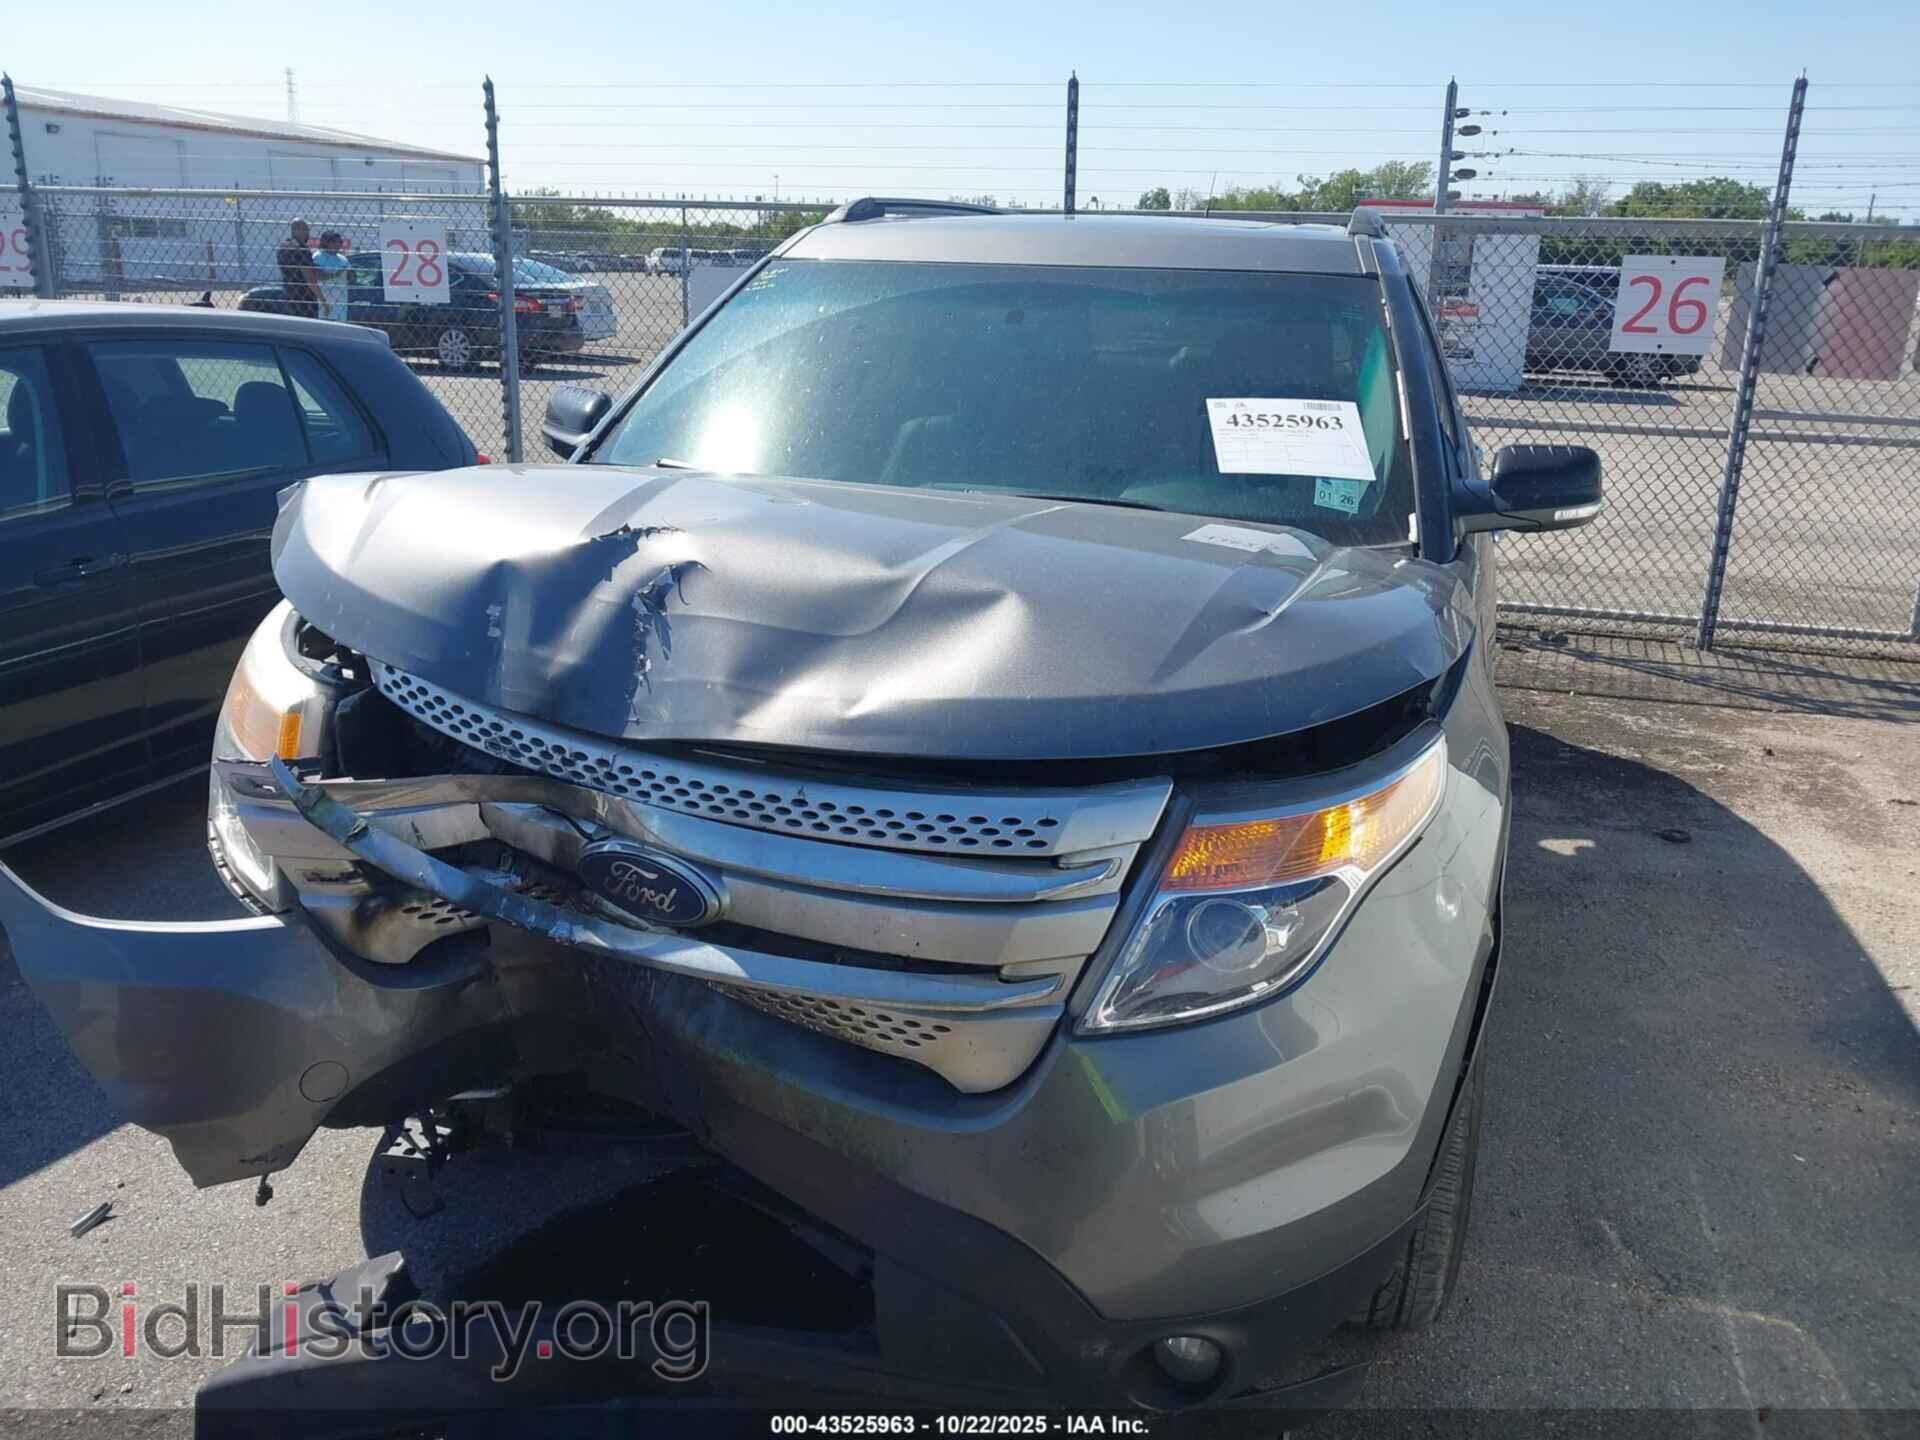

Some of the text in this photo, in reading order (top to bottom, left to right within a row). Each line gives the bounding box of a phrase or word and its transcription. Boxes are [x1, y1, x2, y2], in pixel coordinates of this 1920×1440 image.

[386, 239, 442, 287] 28
[1622, 275, 1710, 335] 26
[1226, 413, 1344, 430] 43525963
[1319, 490, 1331, 500] 01
[604, 861, 677, 912] Ford
